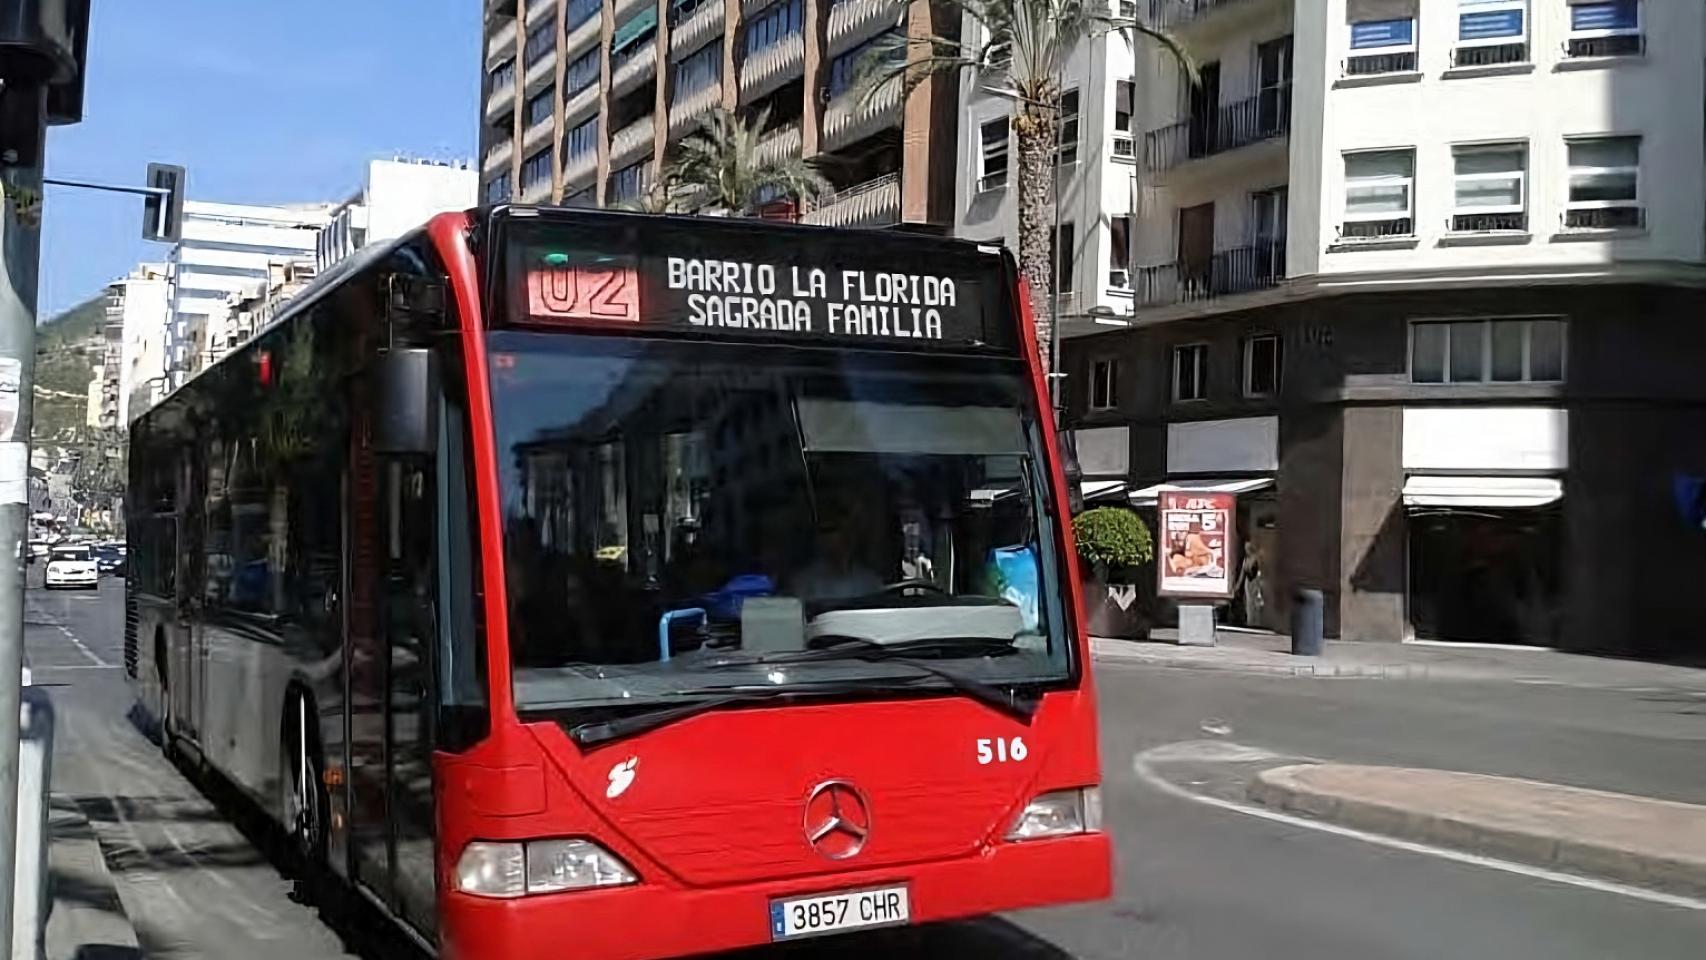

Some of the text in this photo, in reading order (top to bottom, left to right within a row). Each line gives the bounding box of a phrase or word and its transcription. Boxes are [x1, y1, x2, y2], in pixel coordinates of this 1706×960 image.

[667, 256, 956, 307] BARRIO LA FLORIDA
[687, 293, 942, 340] SAGRADA FAMILIA
[976, 736, 1028, 765] 516
[793, 892, 901, 930] 3857 CHR
